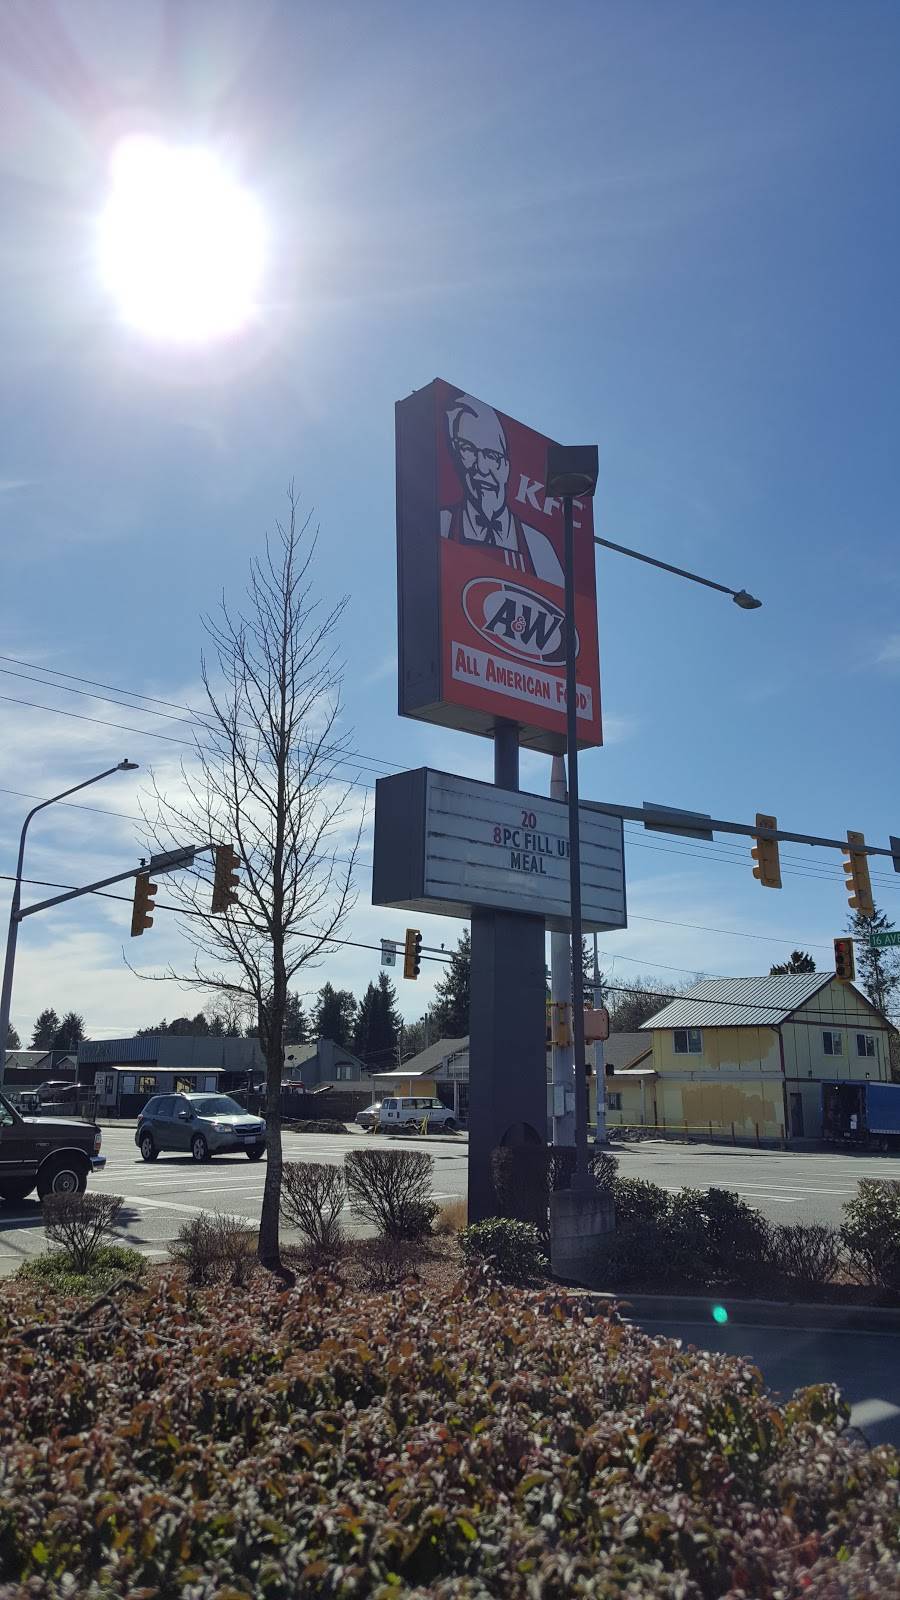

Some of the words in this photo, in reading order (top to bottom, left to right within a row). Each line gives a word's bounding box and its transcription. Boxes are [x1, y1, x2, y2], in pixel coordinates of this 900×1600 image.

[485, 598, 562, 650] A&W
[455, 647, 480, 676] ALL
[485, 658, 550, 700] AMERICAN
[521, 810, 537, 829] 20
[493, 827, 520, 847] 8PC
[524, 833, 552, 854] FILL
[510, 851, 546, 874] MEAL
[873, 936, 881, 945] 16
